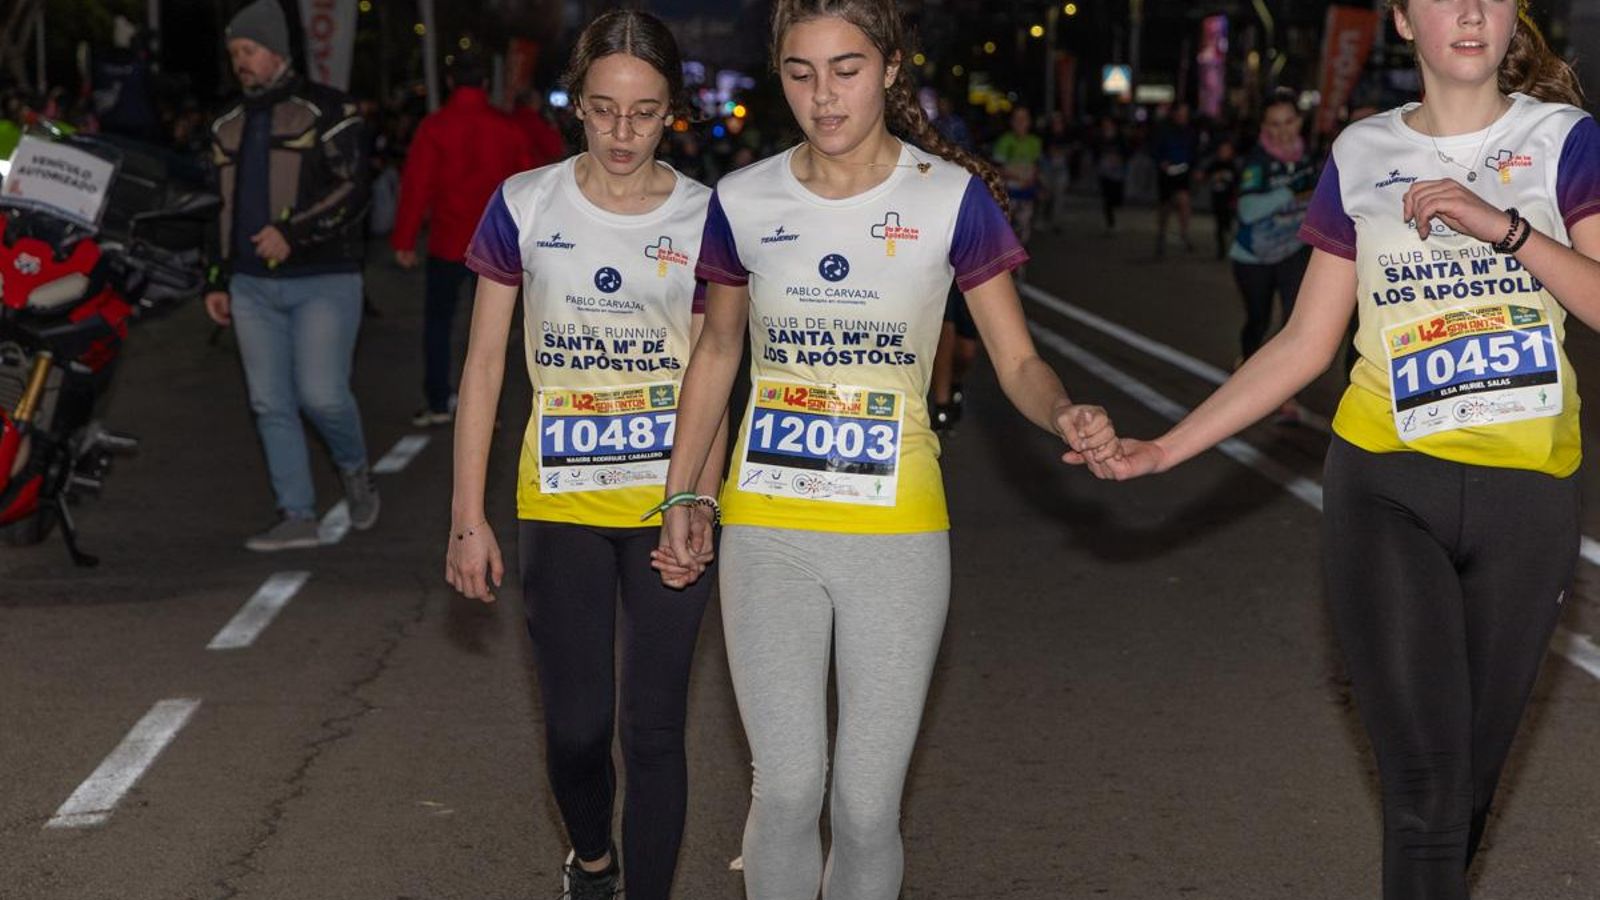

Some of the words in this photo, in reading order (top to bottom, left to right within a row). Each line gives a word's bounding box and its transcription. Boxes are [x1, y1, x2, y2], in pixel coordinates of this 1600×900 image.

[17, 166, 98, 194] AUTORIZADO
[1378, 251, 1424, 267] CLUB
[1431, 248, 1454, 262] DE
[1384, 261, 1465, 283] SANTA
[1505, 256, 1524, 272] D
[566, 295, 595, 307] PABLO
[599, 298, 646, 312] CARVAJAL
[786, 287, 821, 298] PABLO
[825, 287, 880, 300] CARVAJAL
[1373, 285, 1416, 307] LOS
[542, 320, 577, 335] CLUB
[582, 323, 599, 338] DE
[605, 326, 668, 340] RUNNING
[763, 316, 798, 328] CLUB
[805, 317, 827, 330] DE
[833, 319, 908, 334] RUNNING
[1418, 317, 1447, 343] 42
[544, 333, 607, 353] SANTA
[613, 339, 636, 354] Mª
[643, 339, 665, 354] DE
[768, 328, 835, 346] SANTA
[842, 332, 869, 346] Mª
[876, 334, 904, 348] DE
[535, 349, 565, 368] LOS
[571, 351, 681, 372] APÓSTOLES
[763, 344, 788, 364] LOS
[796, 347, 916, 367] APÓSTOLES
[1396, 330, 1547, 393] 10451
[783, 387, 809, 408] 42
[1440, 387, 1458, 396] ELSA
[1487, 378, 1511, 388] SALAS
[572, 393, 595, 411] 42
[545, 413, 677, 453] 10487
[754, 413, 895, 461] 12003
